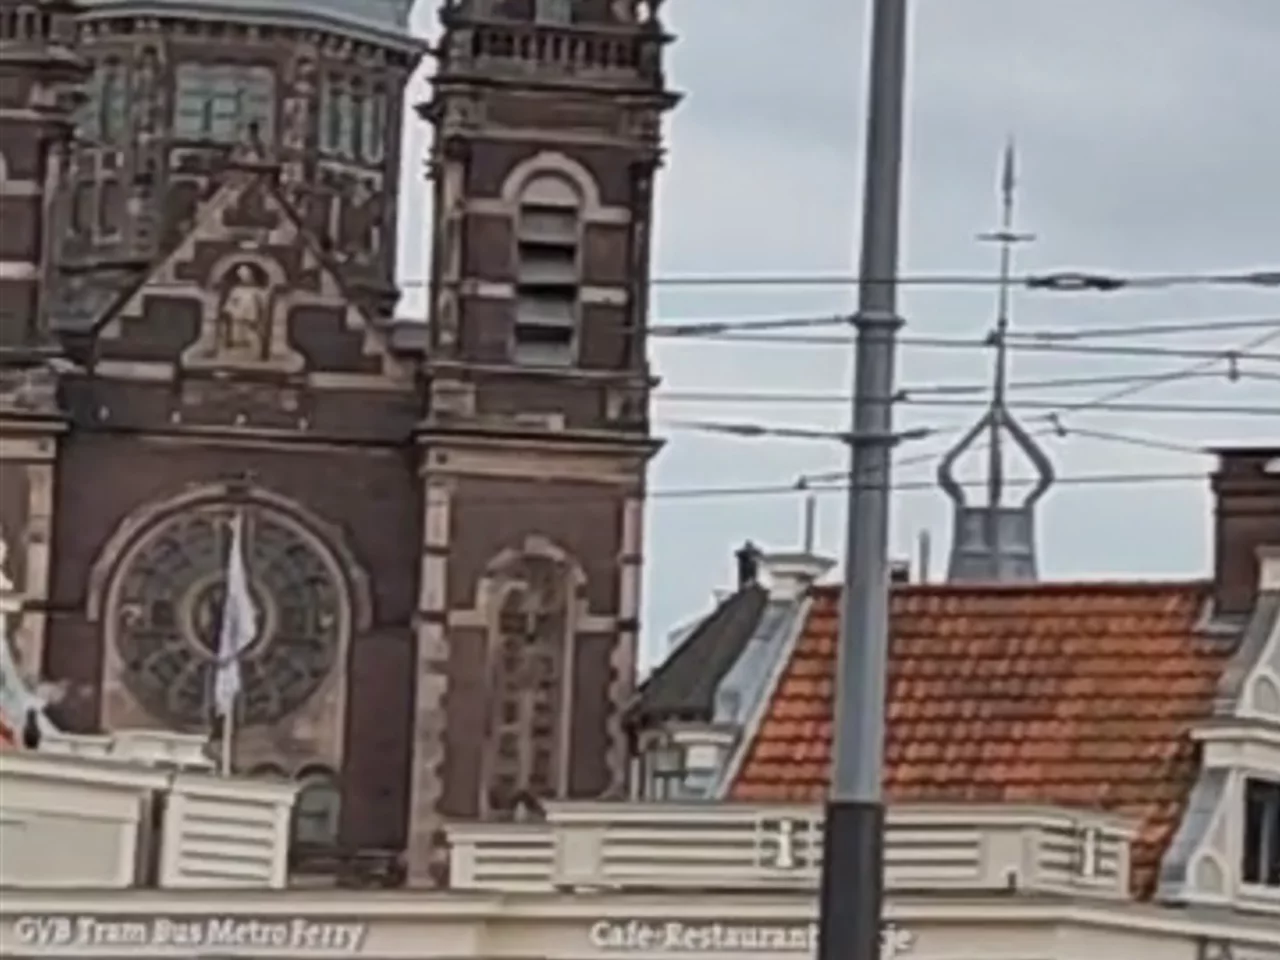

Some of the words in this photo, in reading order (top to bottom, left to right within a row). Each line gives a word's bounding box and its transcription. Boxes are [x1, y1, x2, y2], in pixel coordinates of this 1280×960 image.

[14, 916, 71, 944] GVB
[76, 916, 147, 944] Tram
[153, 917, 202, 945] Bus
[207, 918, 287, 946] Metro
[290, 918, 366, 951] Ferry
